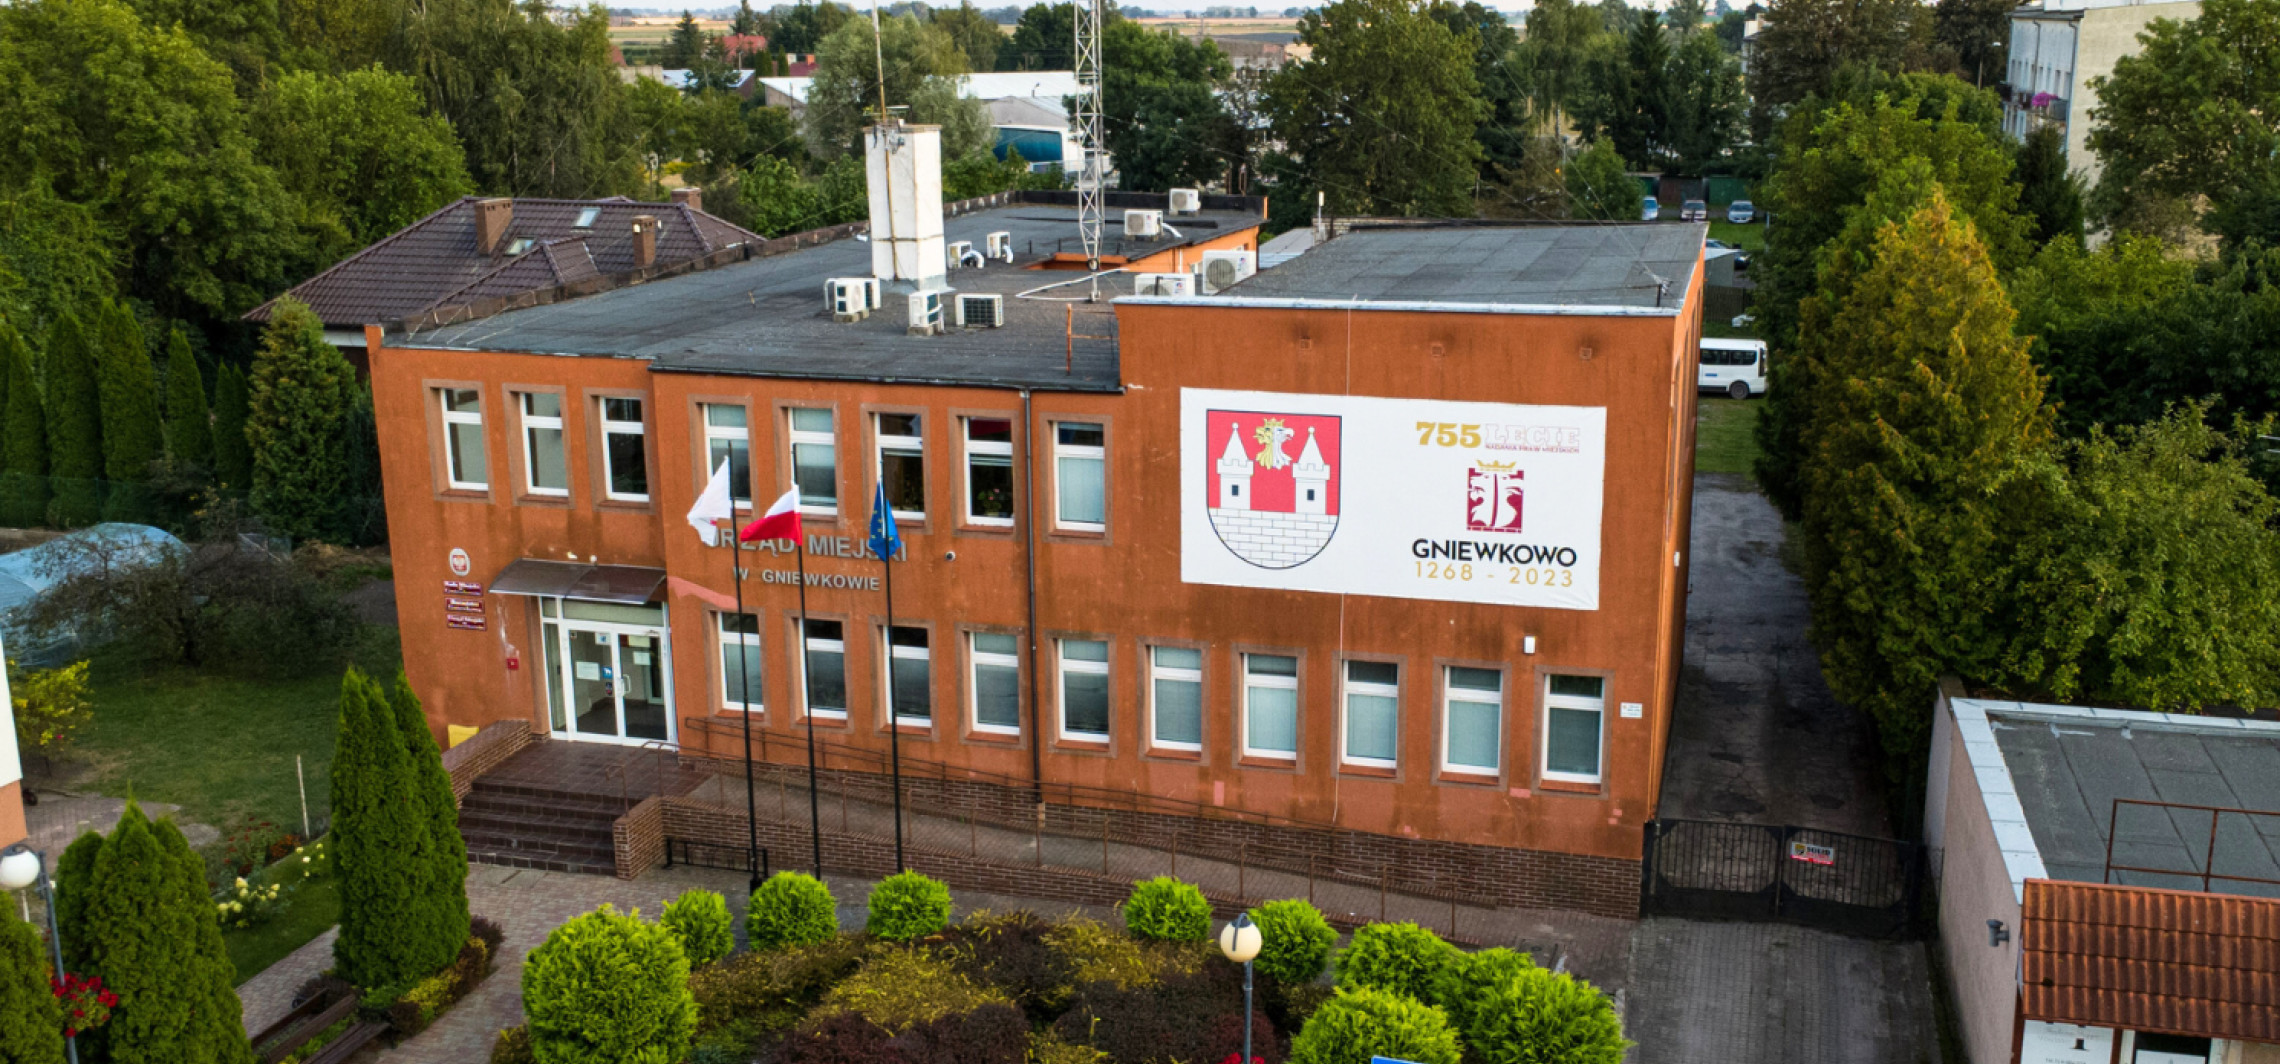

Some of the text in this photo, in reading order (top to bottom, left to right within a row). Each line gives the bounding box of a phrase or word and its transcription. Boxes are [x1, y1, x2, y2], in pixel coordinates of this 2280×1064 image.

[1416, 421, 1580, 448] 755 LECIE
[808, 535, 906, 561] MIEJSI
[1412, 538, 1577, 567] GNIEWKOWO
[733, 566, 880, 591] W GNIEWKOWIE
[1415, 561, 1473, 581] 1268
[1509, 566, 1573, 587] 2023
